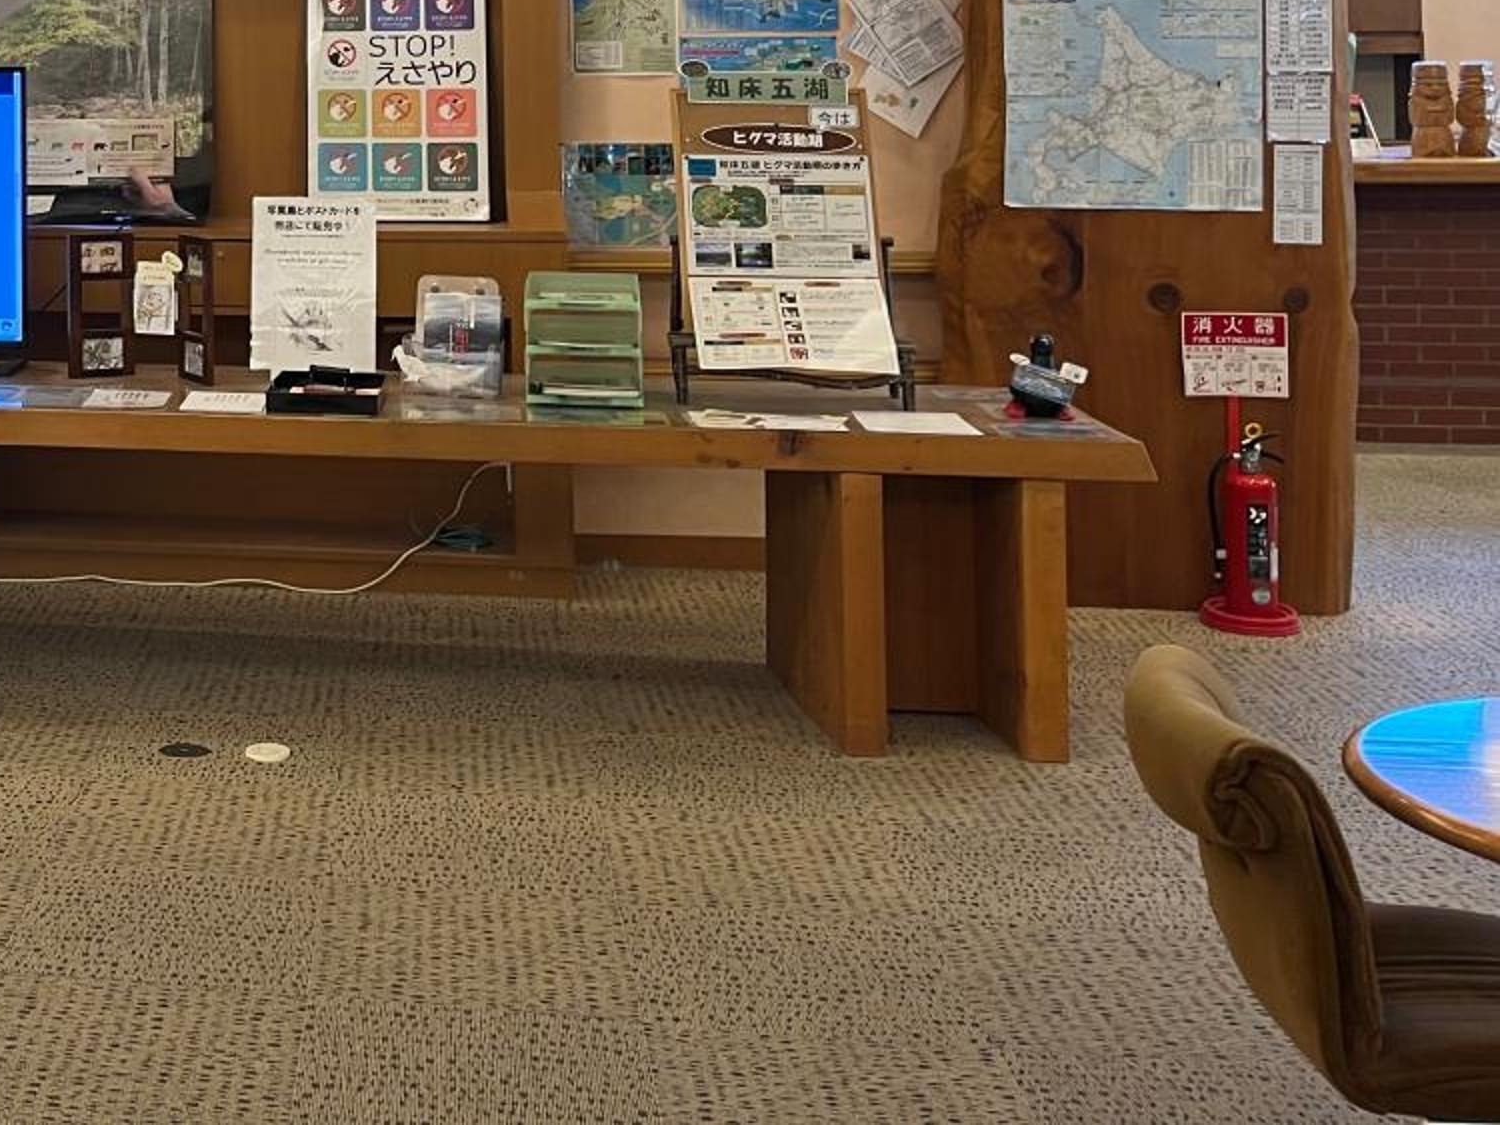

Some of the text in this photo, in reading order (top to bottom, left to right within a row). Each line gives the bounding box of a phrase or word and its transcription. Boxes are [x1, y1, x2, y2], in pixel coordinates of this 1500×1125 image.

[368, 35, 456, 58] STOP!
[374, 60, 477, 86] えさやり
[707, 77, 829, 100] 知床五湖
[818, 111, 851, 124] 今は
[732, 130, 823, 148] ヒグマ活動期
[1192, 316, 1275, 335] 消火器
